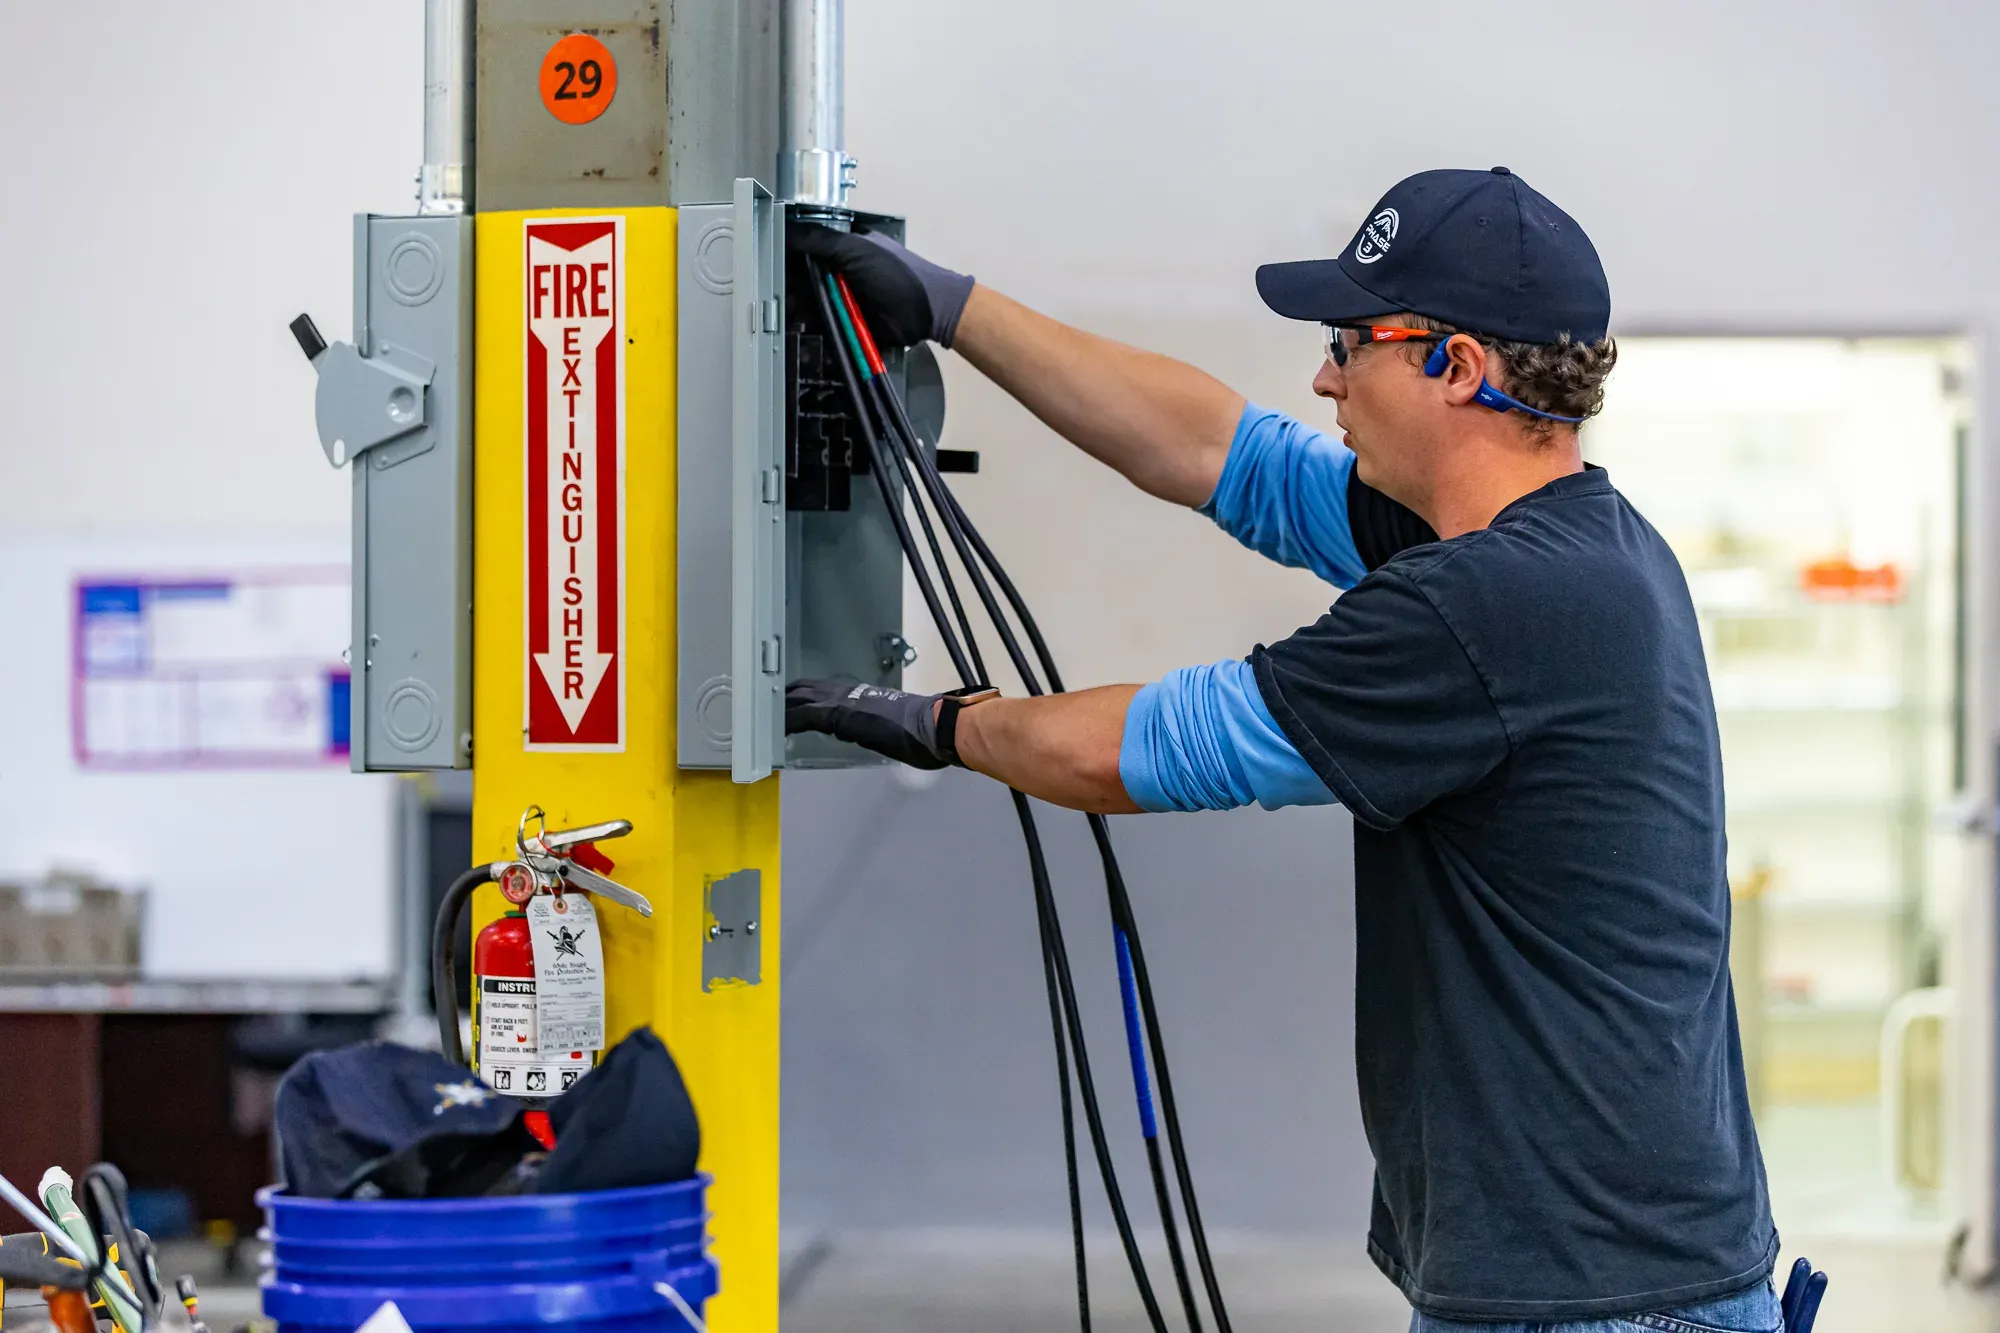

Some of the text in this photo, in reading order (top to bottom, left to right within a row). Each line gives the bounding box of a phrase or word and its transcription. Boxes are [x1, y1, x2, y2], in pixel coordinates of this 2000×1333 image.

[554, 60, 602, 100] 29
[1362, 241, 1373, 254] 3
[1365, 224, 1391, 252] PHASE
[533, 263, 610, 319] FIRE
[562, 327, 584, 699] EXTINGUISHER
